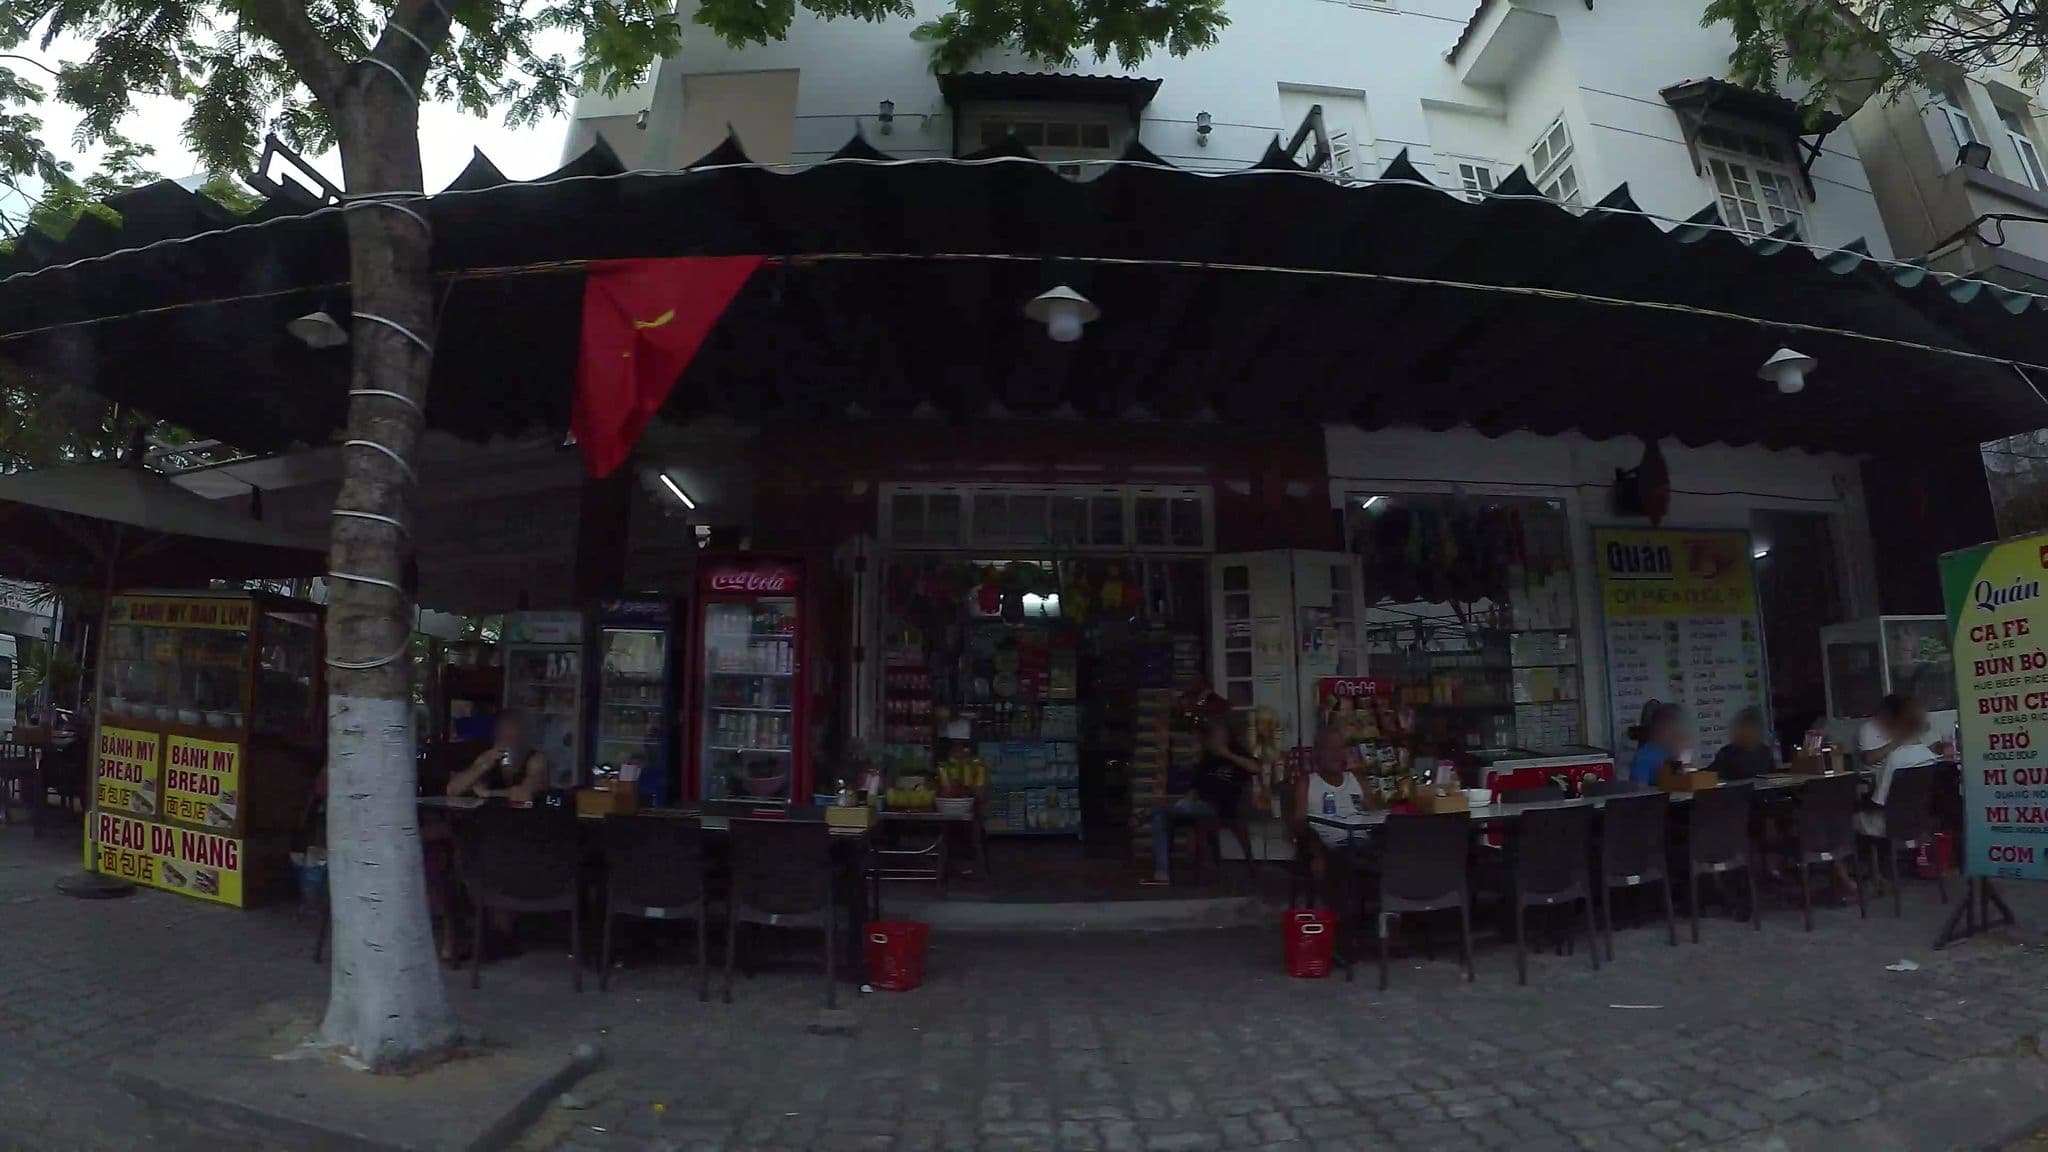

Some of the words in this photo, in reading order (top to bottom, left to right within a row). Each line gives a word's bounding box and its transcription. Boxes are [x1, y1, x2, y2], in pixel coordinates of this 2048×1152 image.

[1975, 576, 2040, 611] Quán
[1974, 653, 2014, 677] BÚN
[2020, 647, 2047, 671] BÒ
[1979, 692, 2018, 714] BÚN
[101, 732, 133, 758] BÁNH
[172, 743, 208, 769] BÁNH
[168, 769, 220, 796] BREAD
[152, 825, 175, 858] DA
[182, 831, 237, 871] NANG
